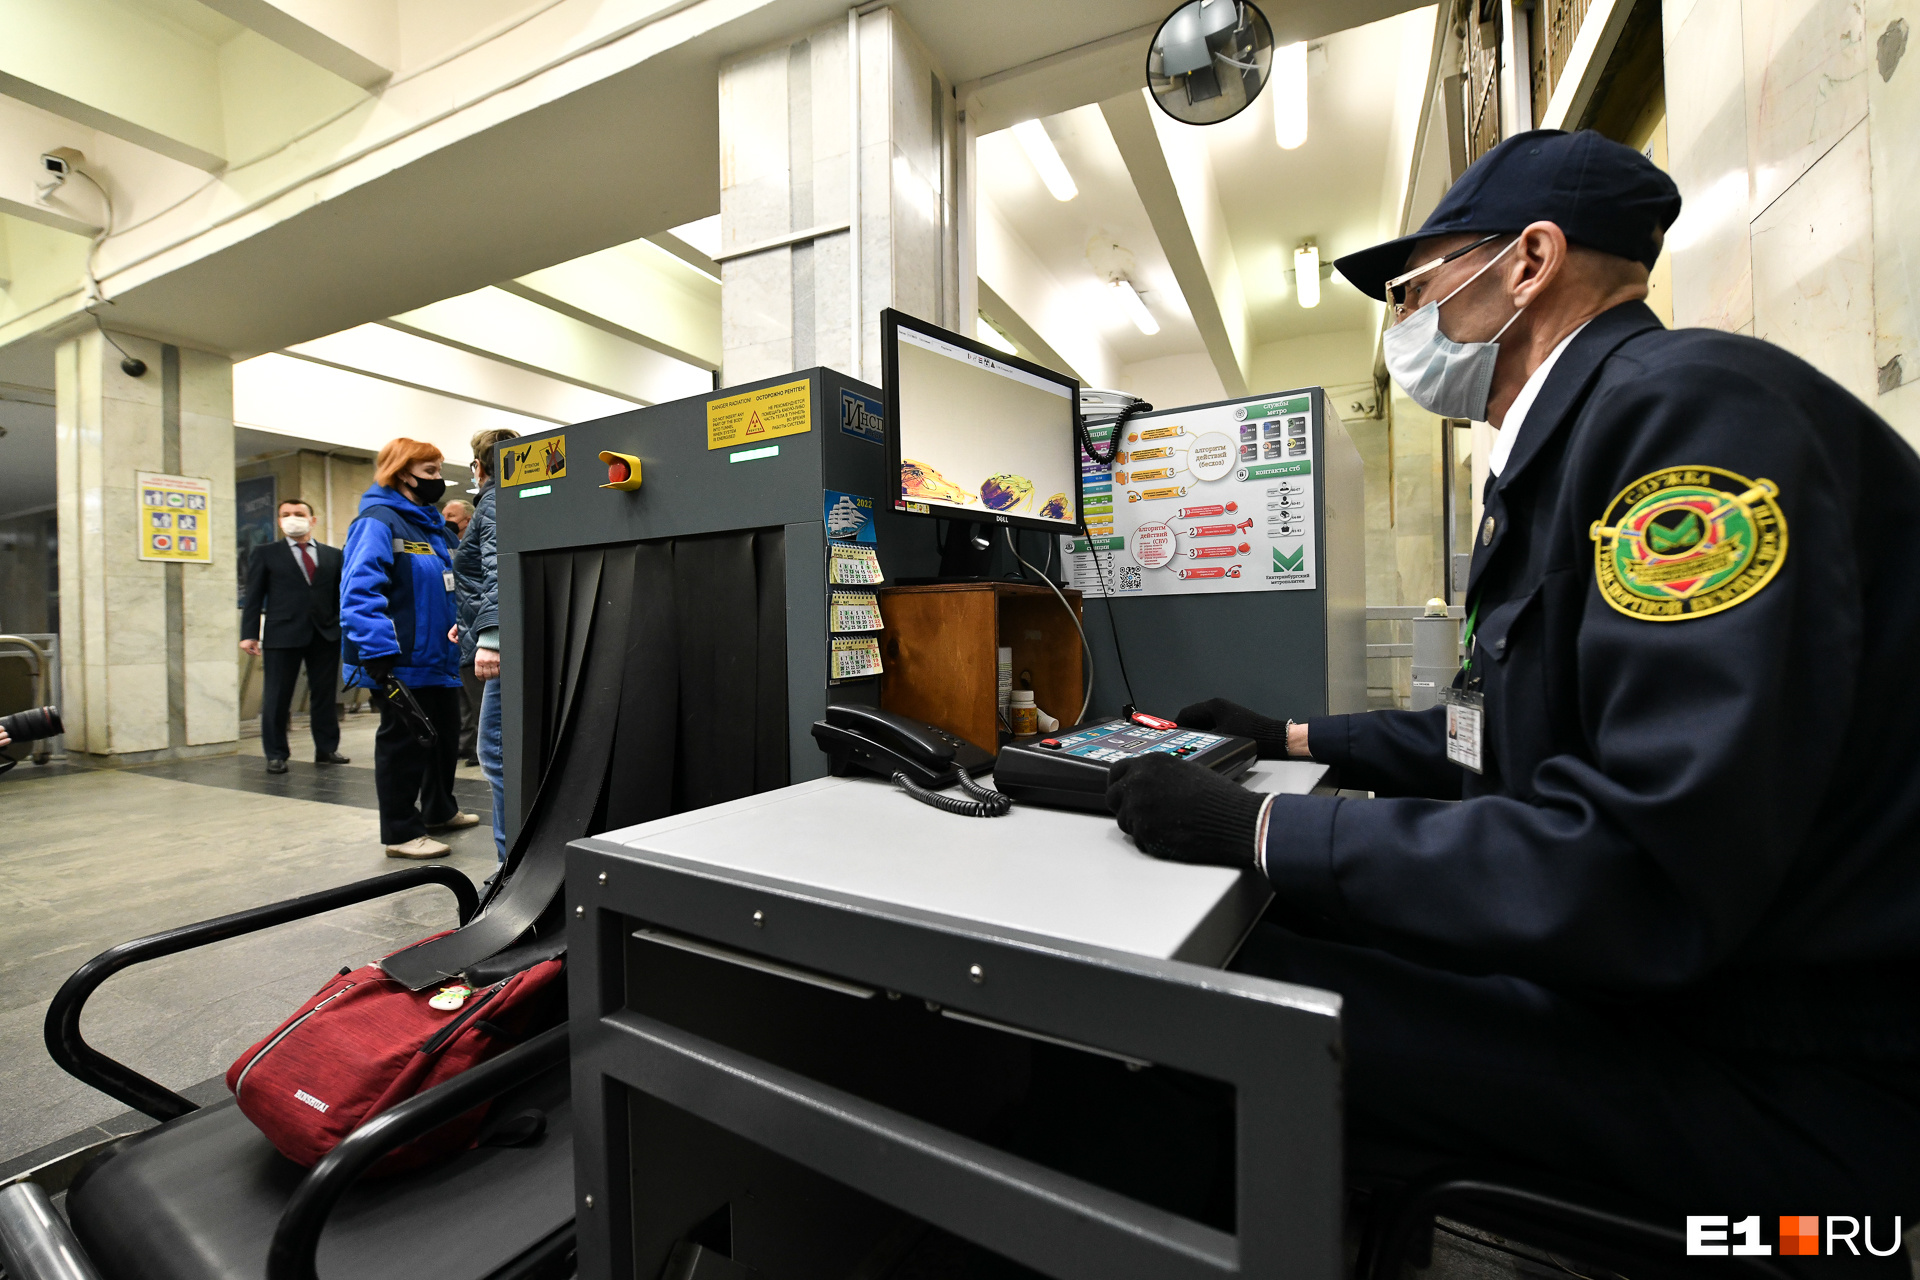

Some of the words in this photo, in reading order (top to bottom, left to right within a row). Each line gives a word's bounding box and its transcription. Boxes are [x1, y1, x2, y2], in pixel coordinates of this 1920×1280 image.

[756, 391, 784, 401] ОСТОРОЖНО
[784, 386, 806, 394] РЕНТГЕН!
[712, 402, 728, 410] DANGER
[729, 398, 751, 407] RADIATION!
[1263, 401, 1289, 409] службы
[1180, 426, 1184, 434] 1
[1168, 447, 1173, 455] 2
[1196, 452, 1227, 461] действий
[1256, 467, 1288, 475] контакты
[857, 498, 872, 508] 2022
[1178, 509, 1183, 517] 1
[1190, 549, 1195, 557] 3
[1179, 570, 1184, 578] 4
